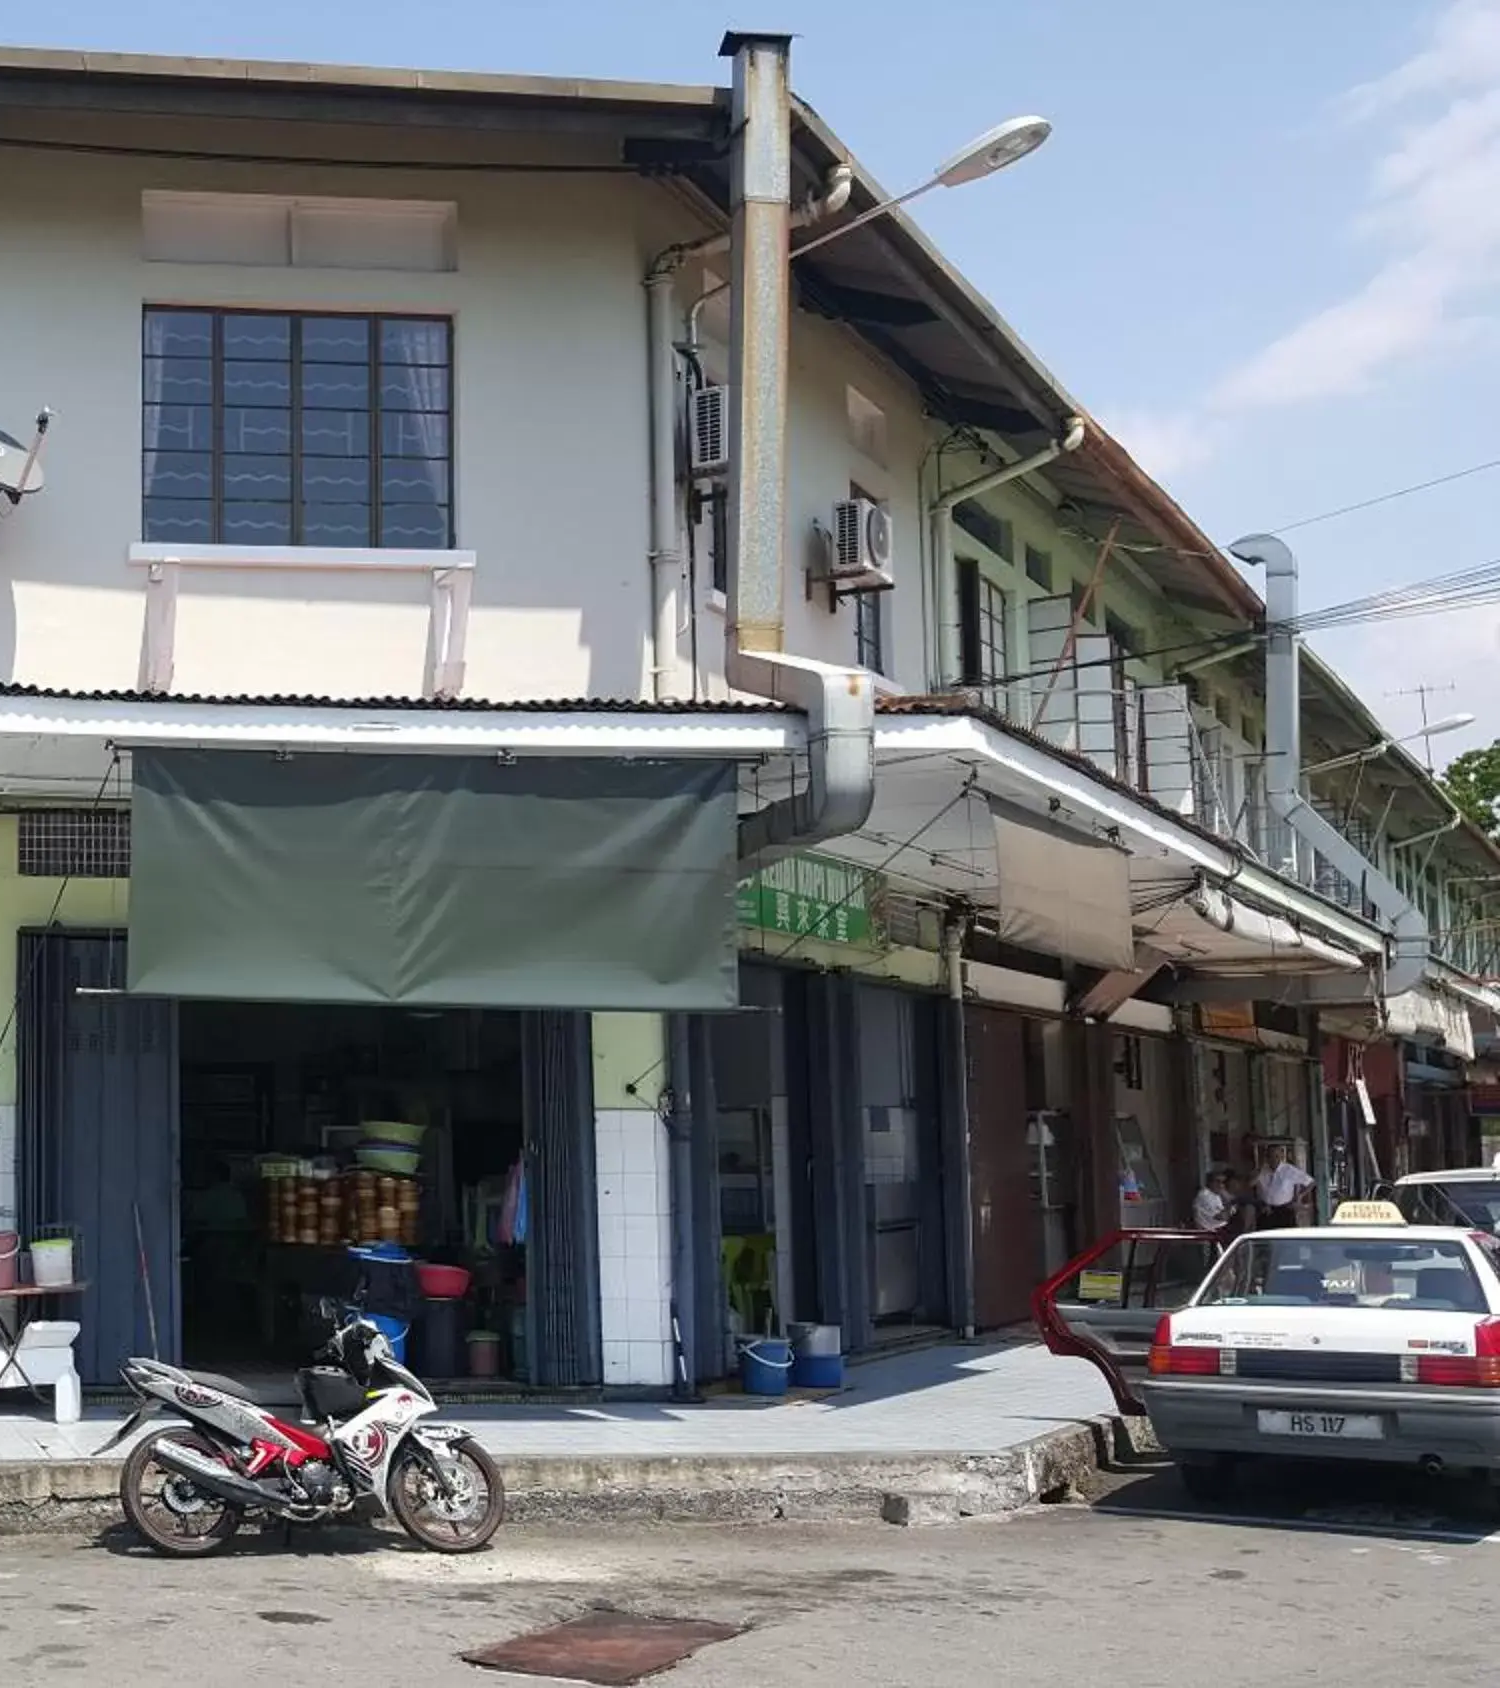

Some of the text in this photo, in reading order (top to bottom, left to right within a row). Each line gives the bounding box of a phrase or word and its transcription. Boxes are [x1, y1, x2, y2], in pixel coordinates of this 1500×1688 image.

[1320, 1279, 1356, 1290] TAXI
[1290, 1415, 1346, 1434] HS 117
